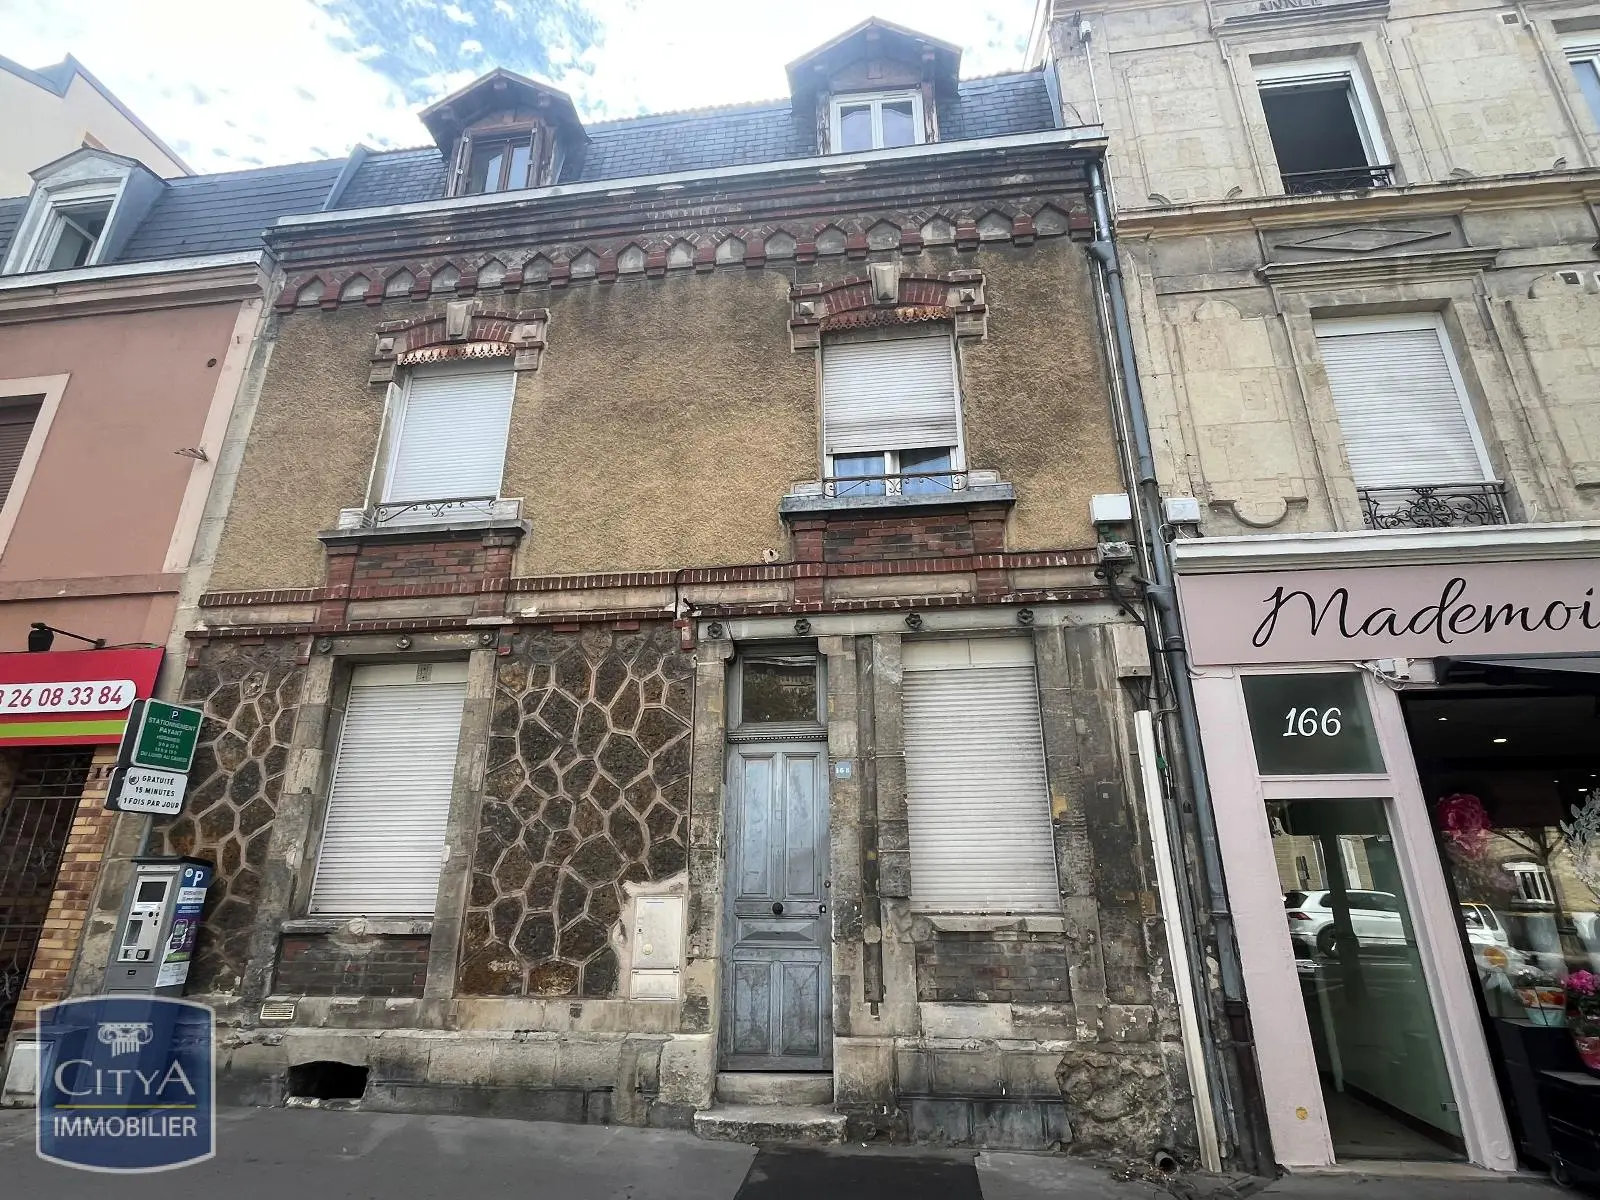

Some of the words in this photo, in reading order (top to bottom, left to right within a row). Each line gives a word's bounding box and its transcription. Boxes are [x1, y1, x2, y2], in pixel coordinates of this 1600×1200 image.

[1252, 577, 1600, 648] Mademoi
[8, 688, 33, 708] 26
[38, 687, 64, 706] 08
[67, 686, 94, 705] 33
[98, 685, 123, 705] 84
[171, 710, 179, 719] P
[1282, 707, 1342, 737] 166
[158, 726, 183, 737] PAYANT
[142, 775, 175, 786] GRATUITÉ
[135, 786, 143, 794] 15
[145, 788, 175, 797] MINUTES
[128, 797, 145, 806] FOIS
[146, 799, 160, 807] PAR
[161, 801, 180, 809] JOUR
[192, 870, 204, 887] P
